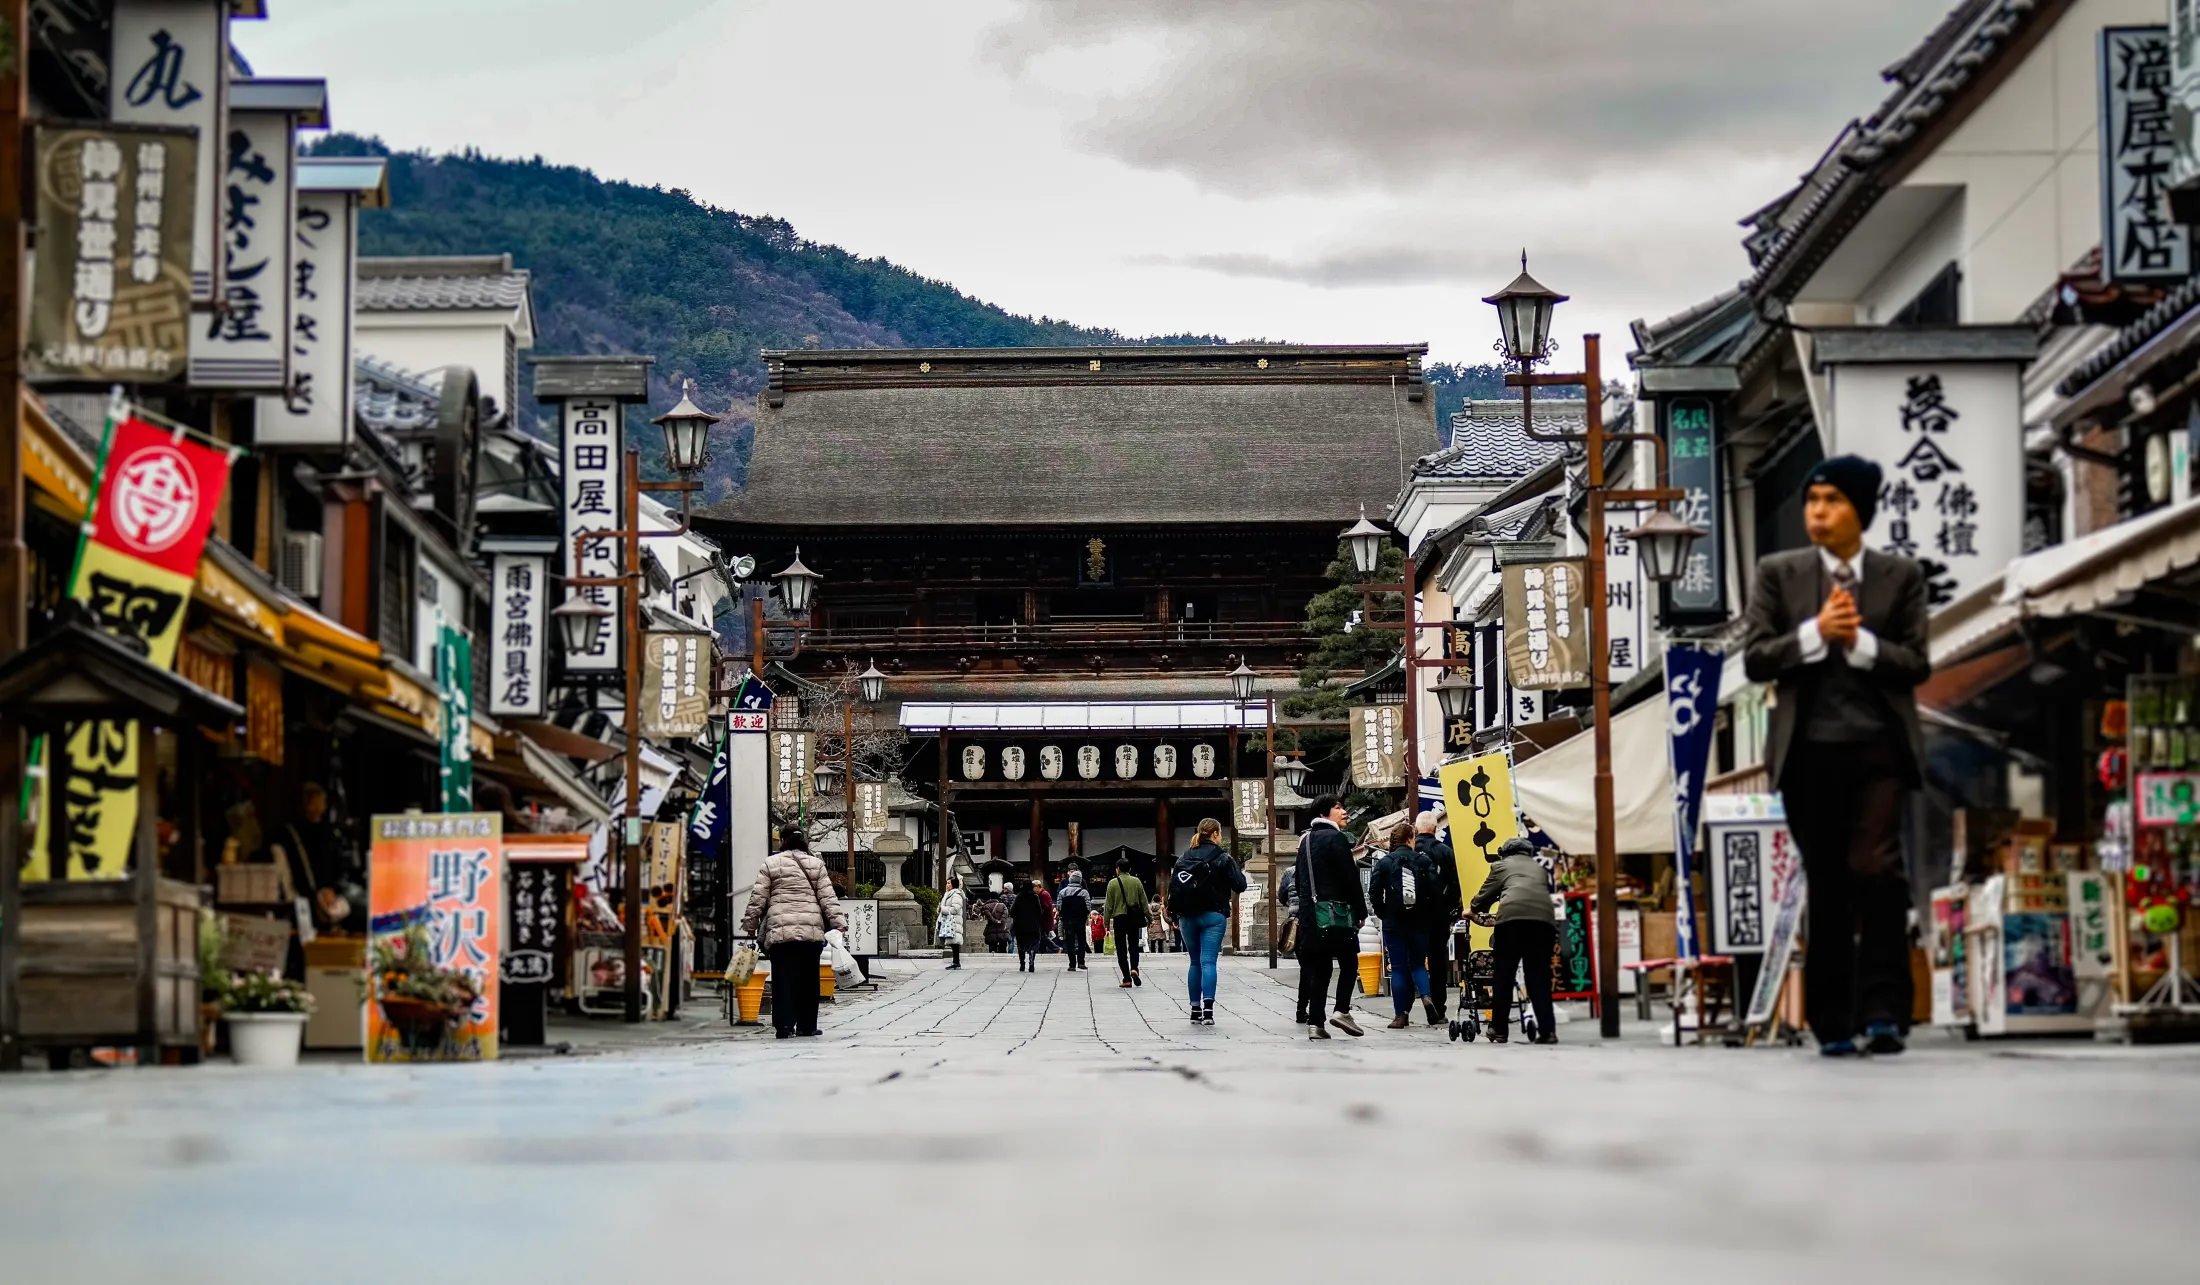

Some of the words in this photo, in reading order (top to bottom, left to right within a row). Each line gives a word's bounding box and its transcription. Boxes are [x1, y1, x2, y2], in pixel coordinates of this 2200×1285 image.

[1896, 374, 1964, 482] 落合
[502, 564, 533, 706] 雨宮佛具店
[1604, 526, 1632, 669] 信州屋
[733, 715, 764, 730] 歓迎
[1447, 629, 1473, 746] 高店
[1519, 696, 1534, 721] き
[1402, 868, 1416, 900] NIKE
